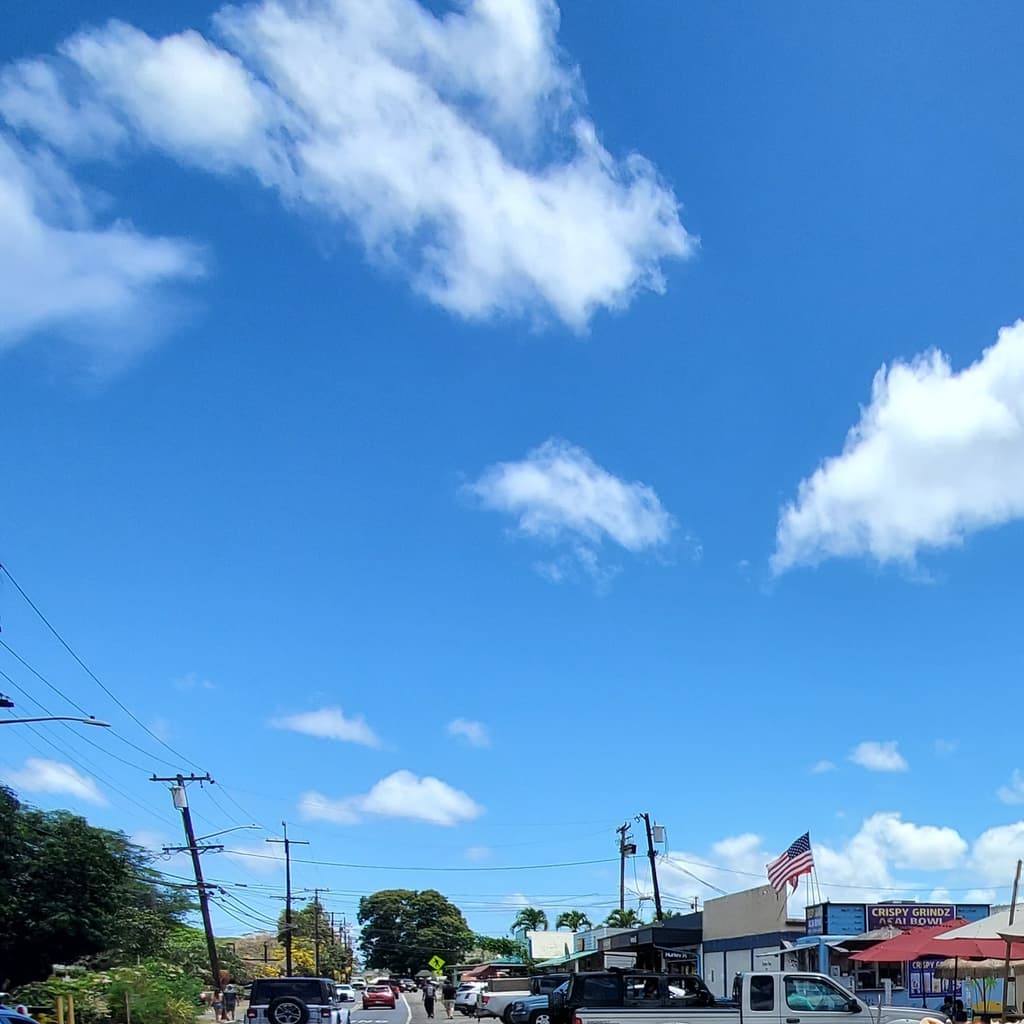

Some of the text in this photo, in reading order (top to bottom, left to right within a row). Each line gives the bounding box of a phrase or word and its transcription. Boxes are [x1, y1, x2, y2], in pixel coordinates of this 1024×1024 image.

[871, 907, 909, 917] CRISPY
[911, 907, 951, 917] GRINDZ
[912, 961, 935, 969] CRSPY
